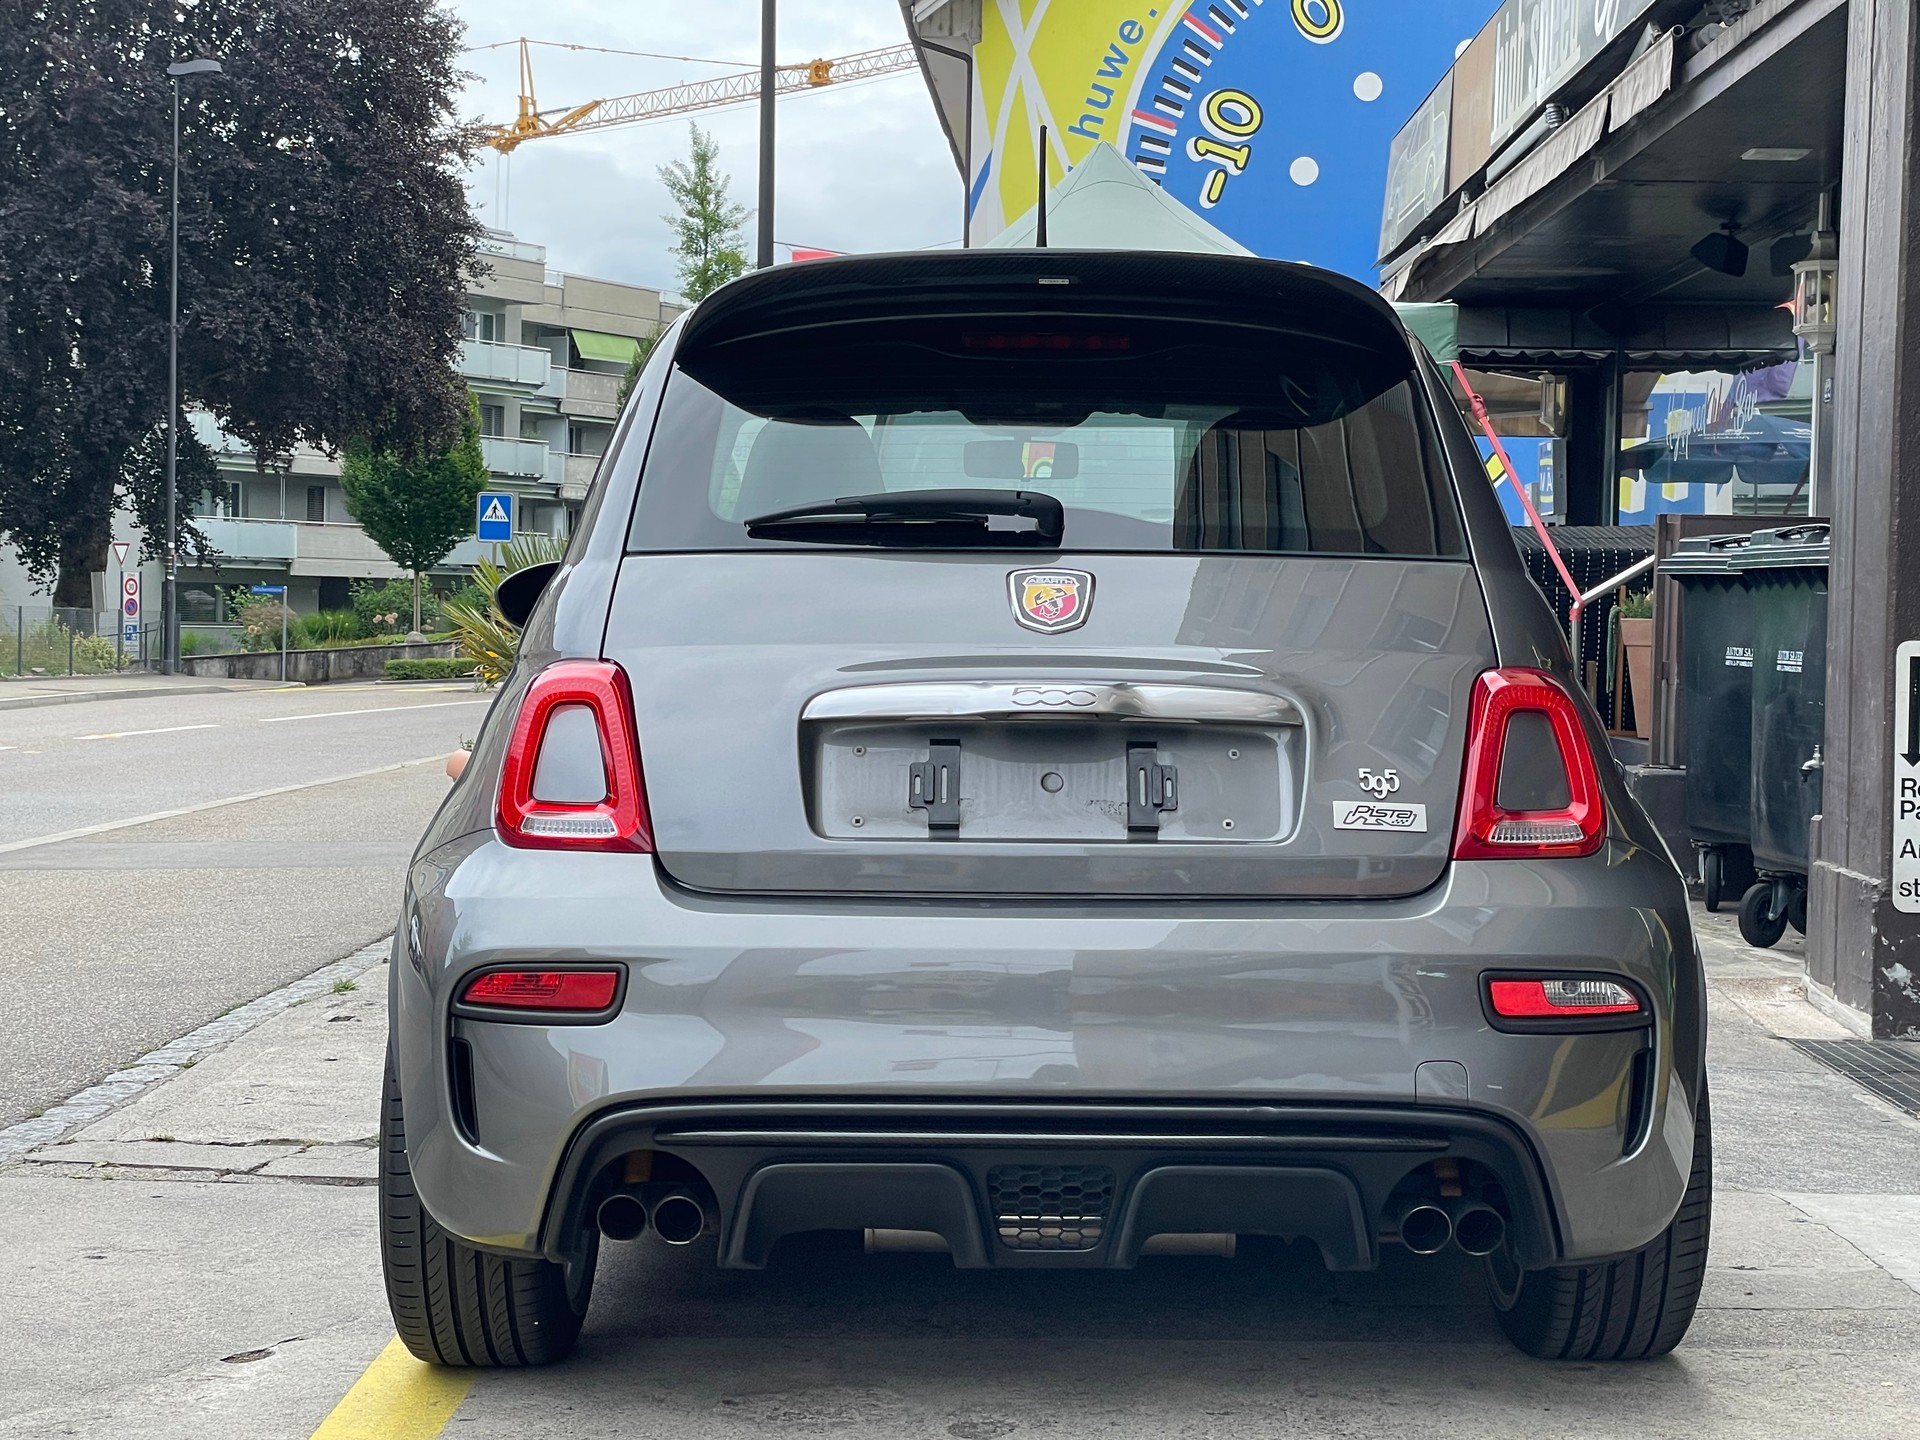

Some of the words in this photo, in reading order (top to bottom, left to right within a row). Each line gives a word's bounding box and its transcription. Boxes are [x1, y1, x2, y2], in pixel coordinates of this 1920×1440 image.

[1068, 8, 1158, 140] huwe.
[1190, 88, 1264, 206] -10
[128, 583, 135, 591] 30
[1028, 577, 1074, 585] ABARTH
[1012, 686, 1098, 707] 500
[1358, 767, 1400, 800] 595
[1901, 777, 1920, 798] R
